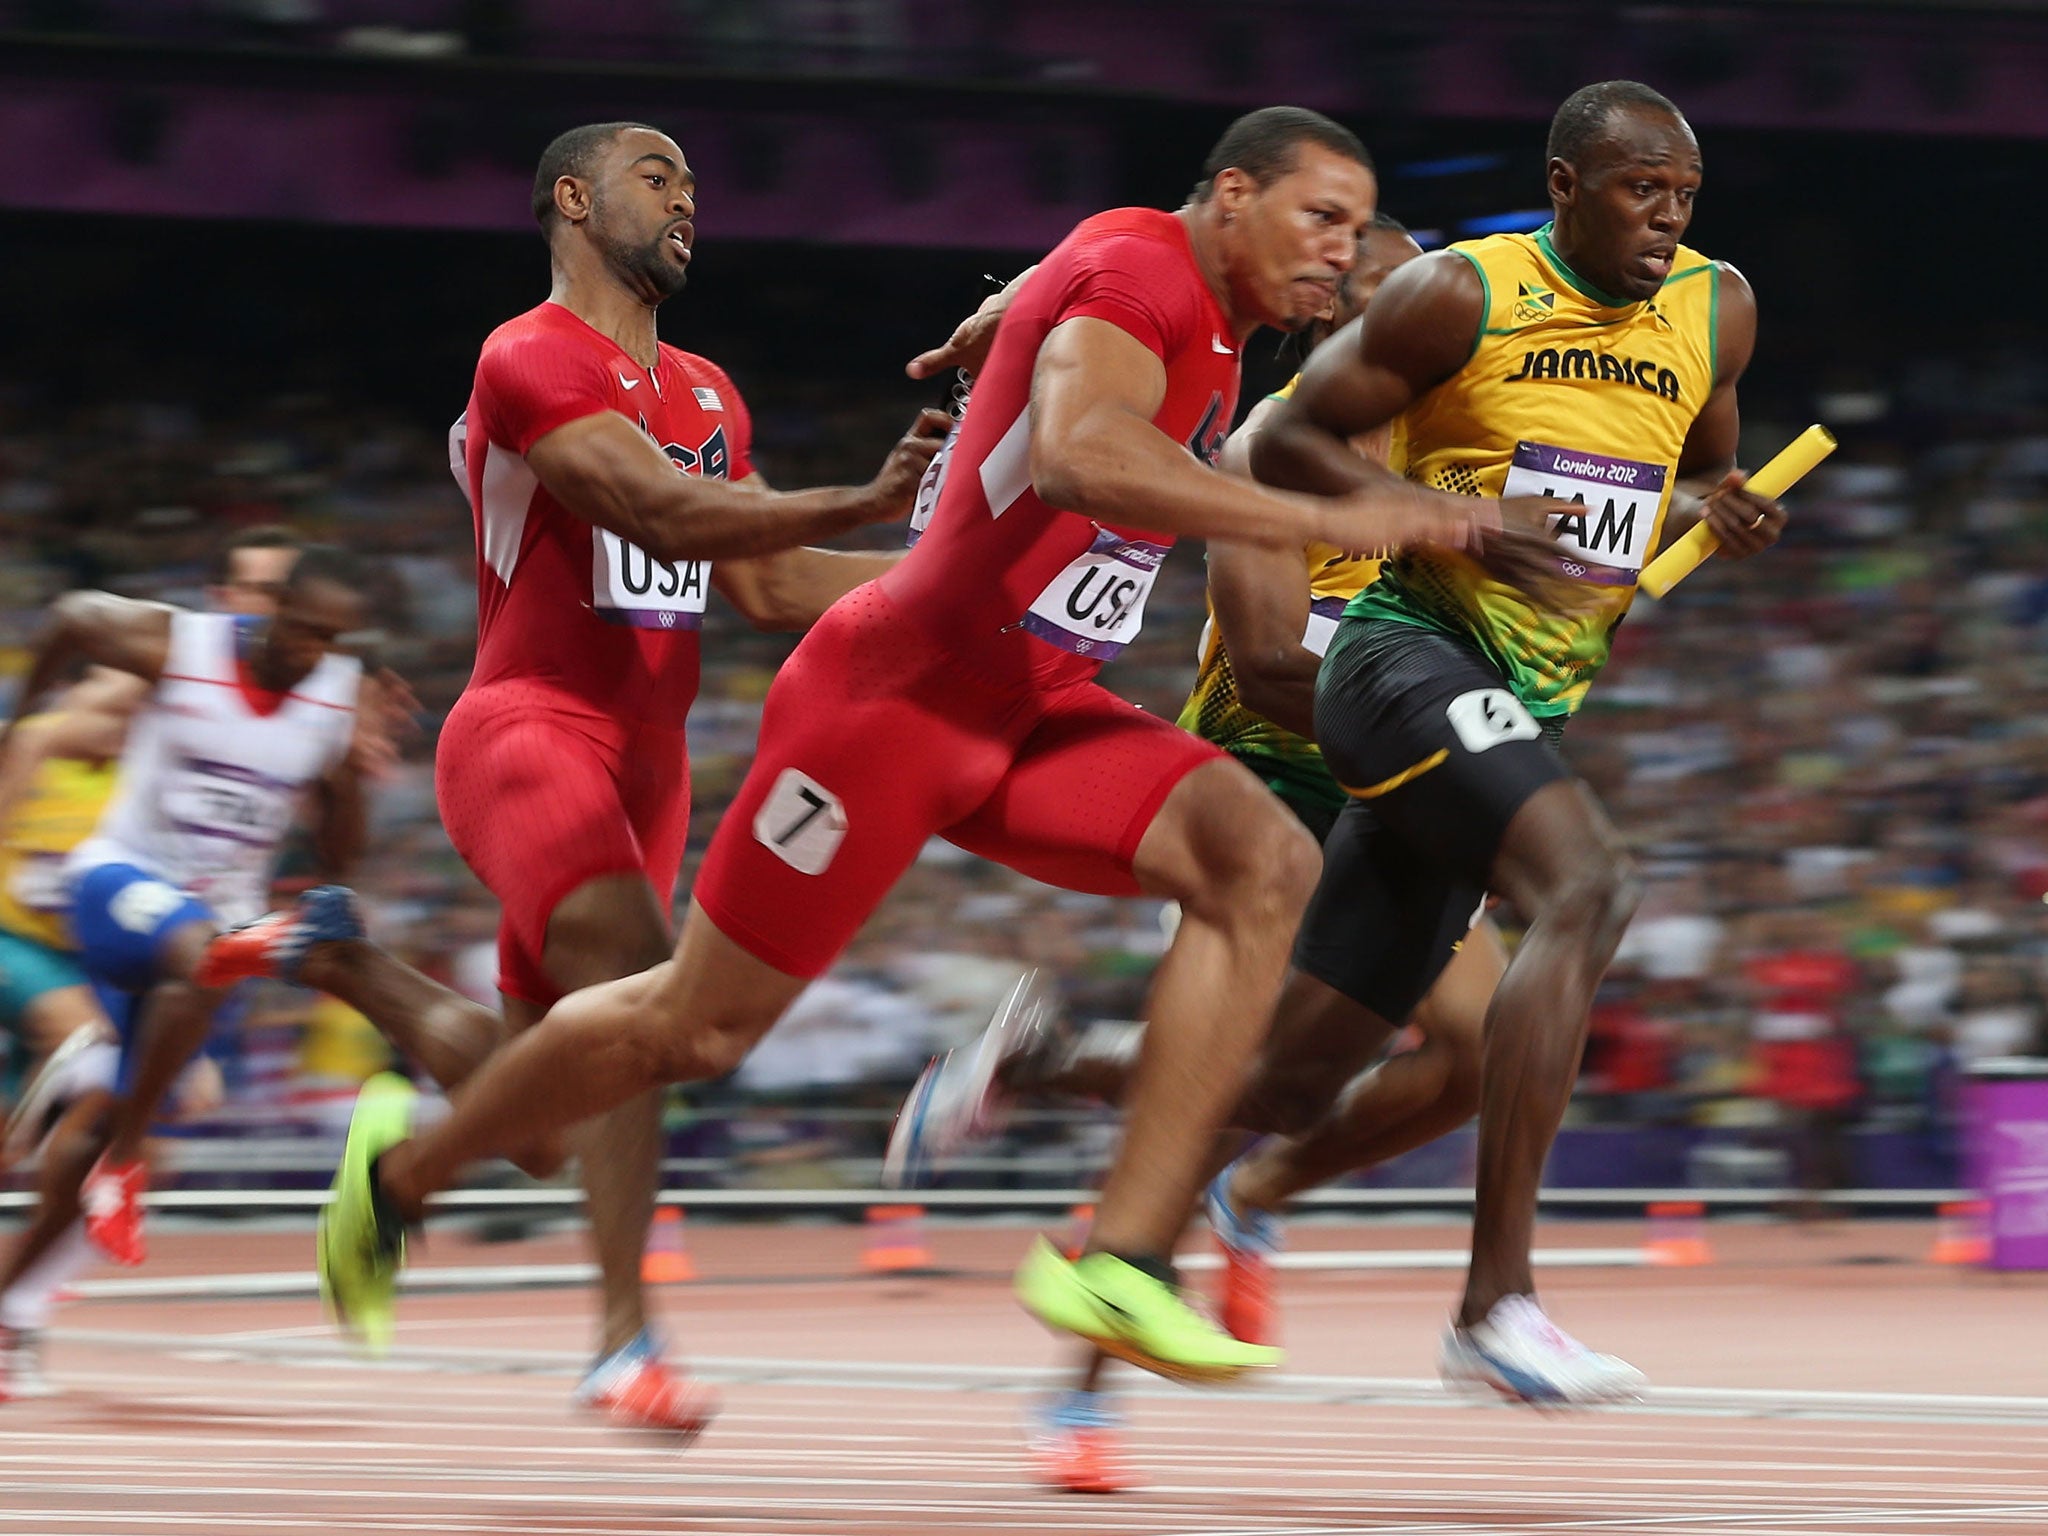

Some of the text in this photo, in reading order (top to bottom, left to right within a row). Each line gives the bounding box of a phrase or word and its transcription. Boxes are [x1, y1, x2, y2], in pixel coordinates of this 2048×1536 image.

[1503, 348, 1680, 403] JAMAICA
[638, 410, 732, 483] SA
[1553, 453, 1638, 484] London 2012
[1543, 487, 1638, 556] AM
[619, 540, 702, 599] USA
[773, 784, 832, 848] 7
